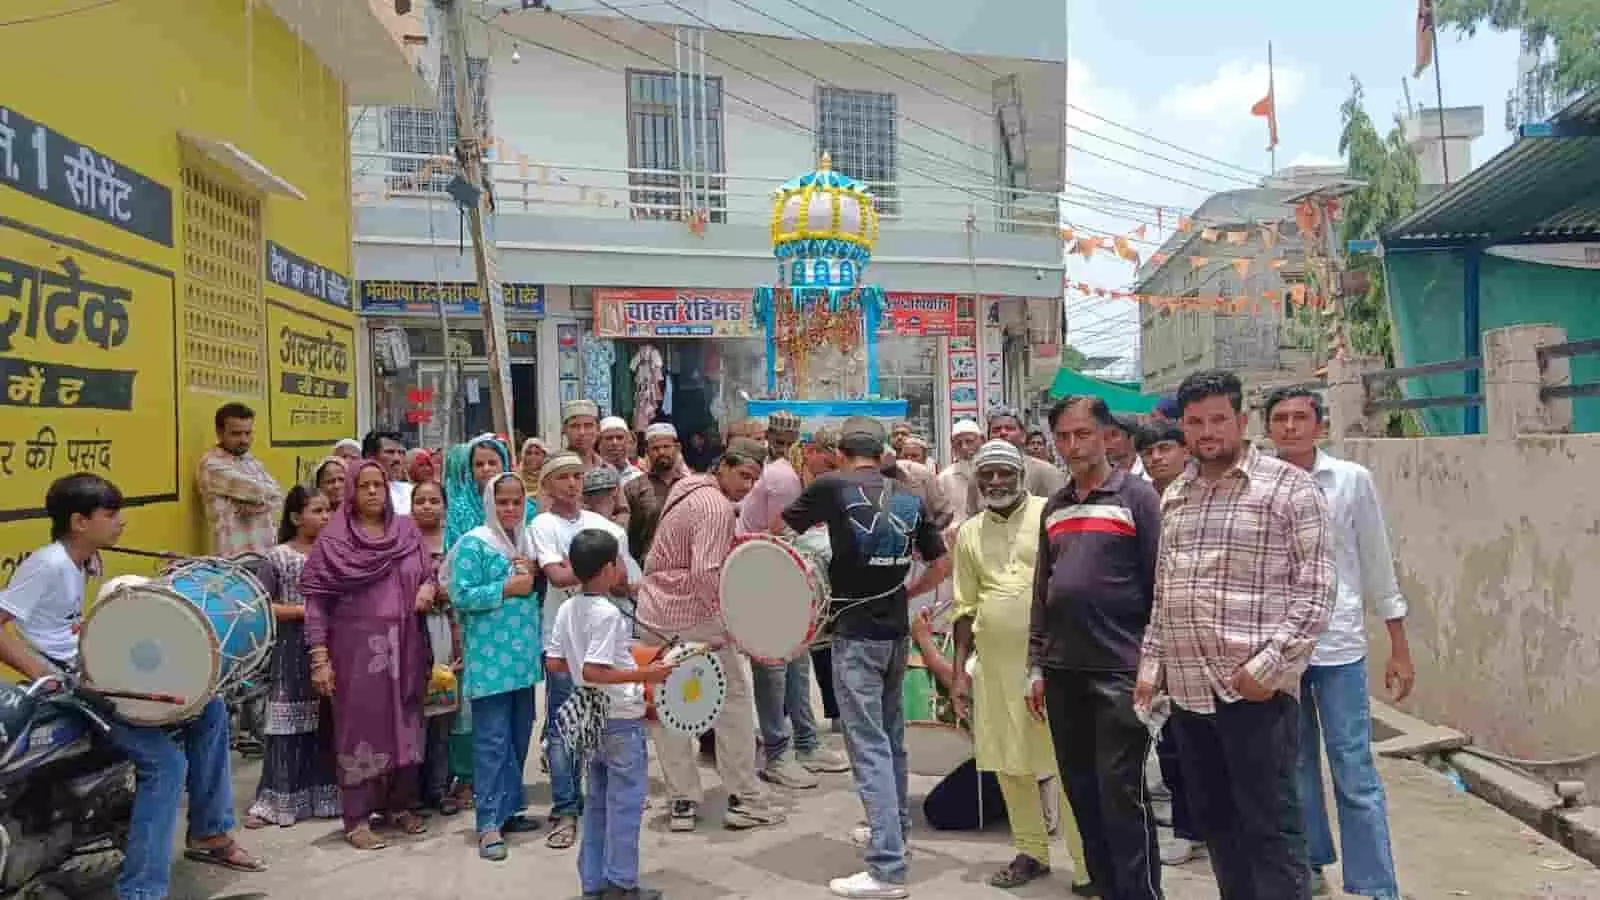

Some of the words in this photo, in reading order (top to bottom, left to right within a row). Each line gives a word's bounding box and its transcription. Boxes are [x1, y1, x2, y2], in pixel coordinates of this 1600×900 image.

[32, 126, 48, 190] 1
[25, 425, 58, 472] की
[66, 427, 112, 472] पसंद
